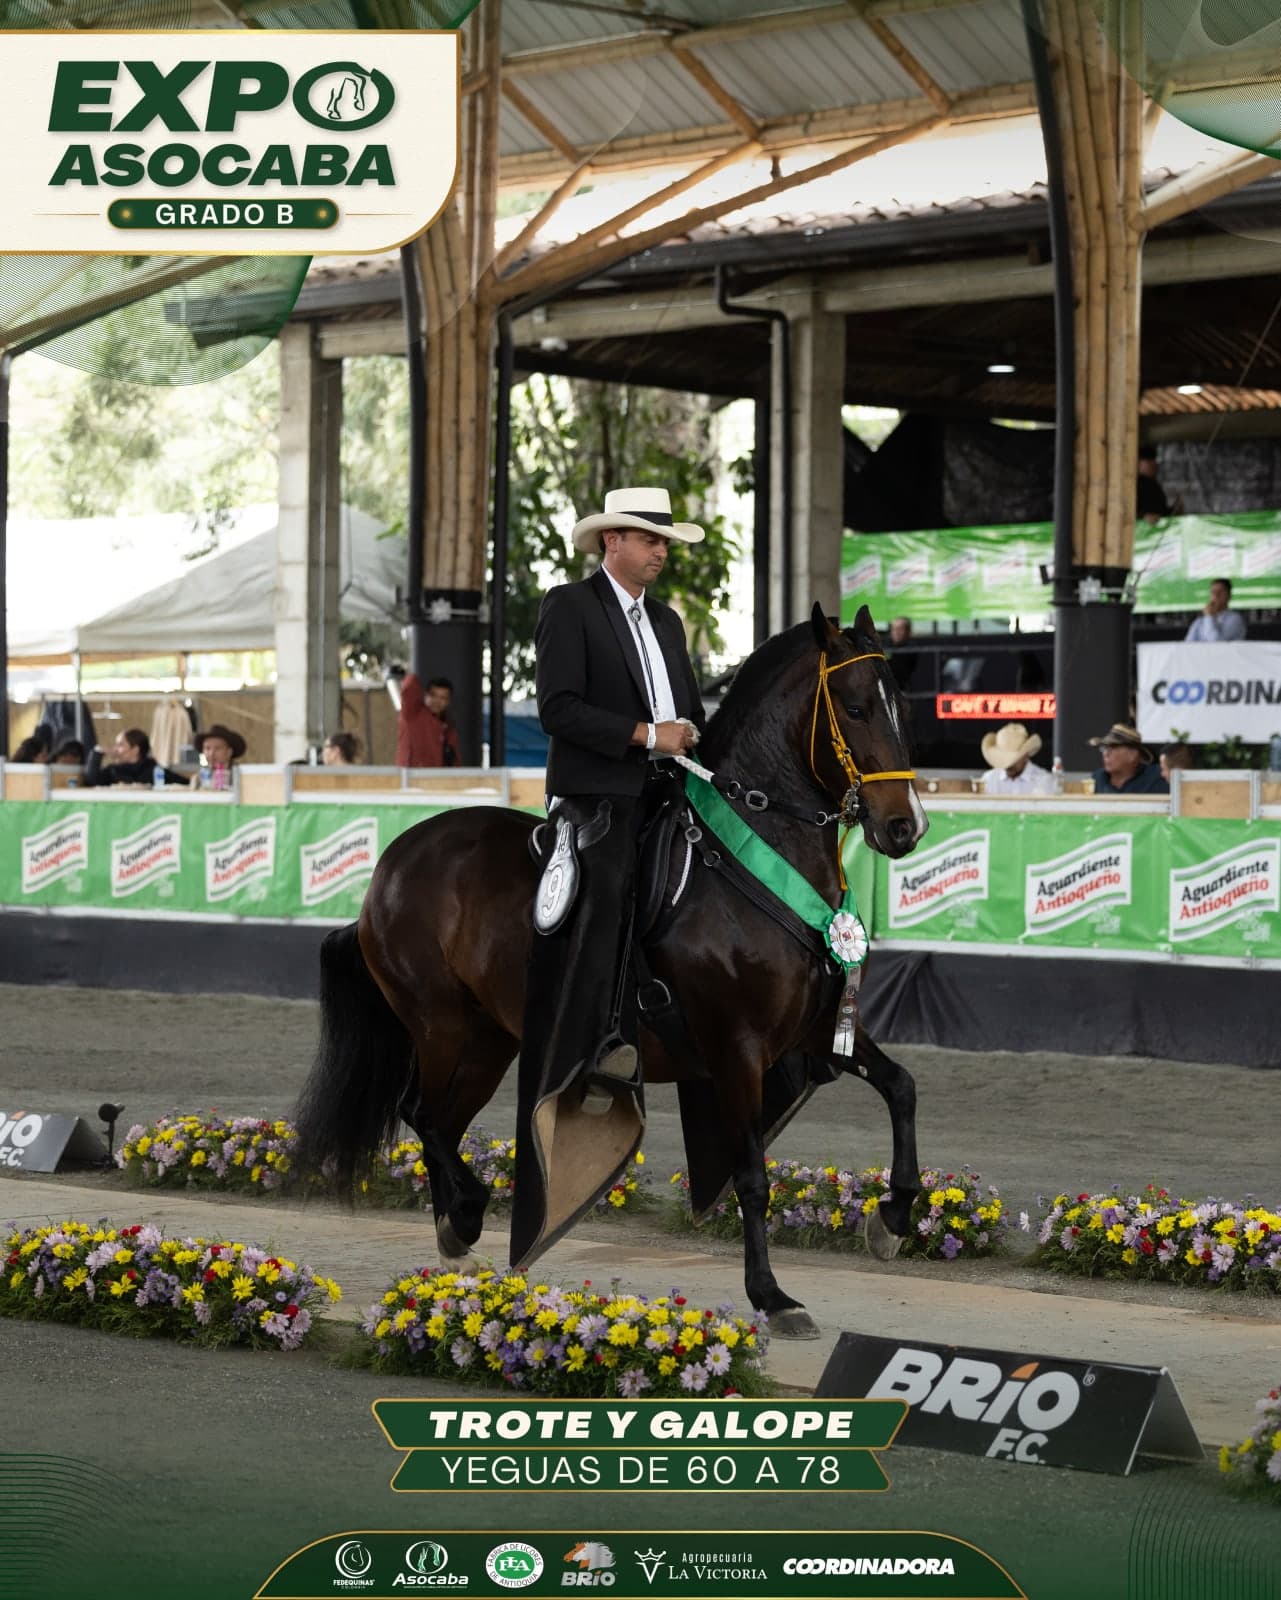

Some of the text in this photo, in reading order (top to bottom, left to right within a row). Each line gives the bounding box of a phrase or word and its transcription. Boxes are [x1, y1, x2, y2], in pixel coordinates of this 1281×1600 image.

[1151, 680, 1281, 704] COORDIN
[898, 865, 980, 908] Antioqueño
[901, 851, 979, 890] Aguardiente
[1037, 856, 1120, 897] Aguardiente
[1182, 861, 1269, 903] Aguardiente
[1035, 870, 1121, 914] Antioqueño
[1180, 875, 1270, 919] Antioqueño
[985, 1428, 1046, 1464] F.C.
